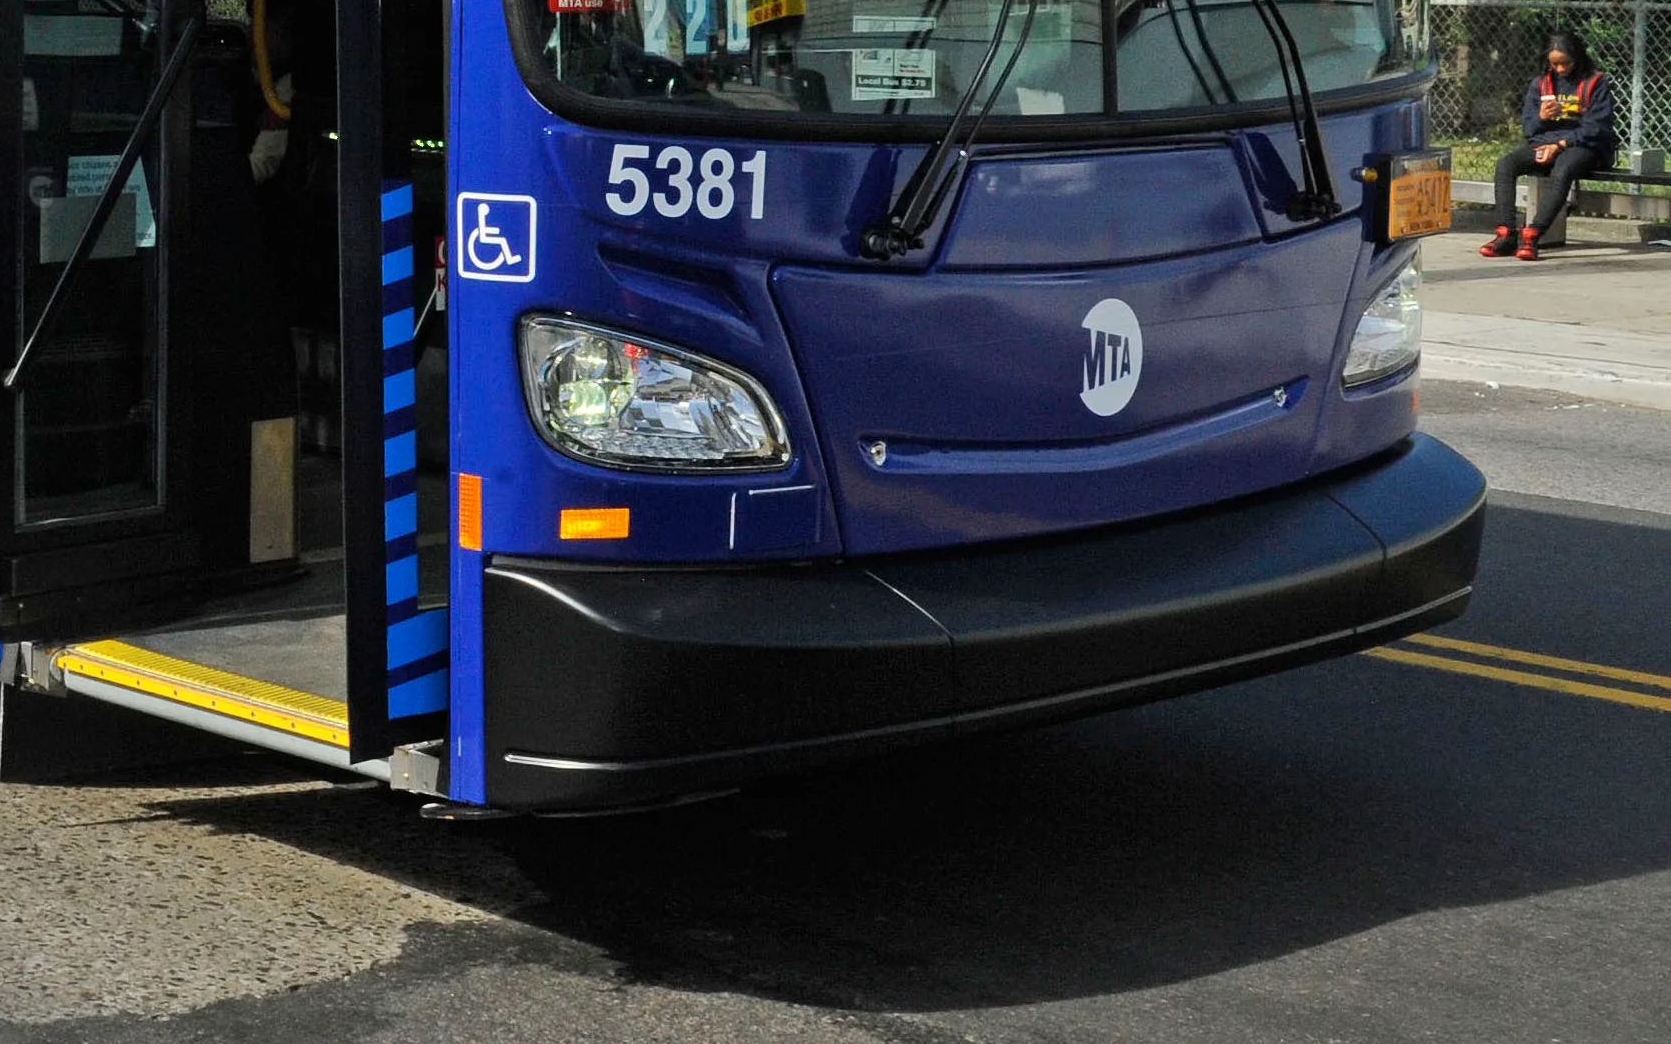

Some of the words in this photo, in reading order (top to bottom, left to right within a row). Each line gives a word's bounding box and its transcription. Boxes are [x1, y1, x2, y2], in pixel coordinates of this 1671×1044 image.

[584, 0, 603, 8] use
[857, 76, 881, 85] Local
[882, 77, 899, 86] Bus
[605, 143, 767, 219] 5381
